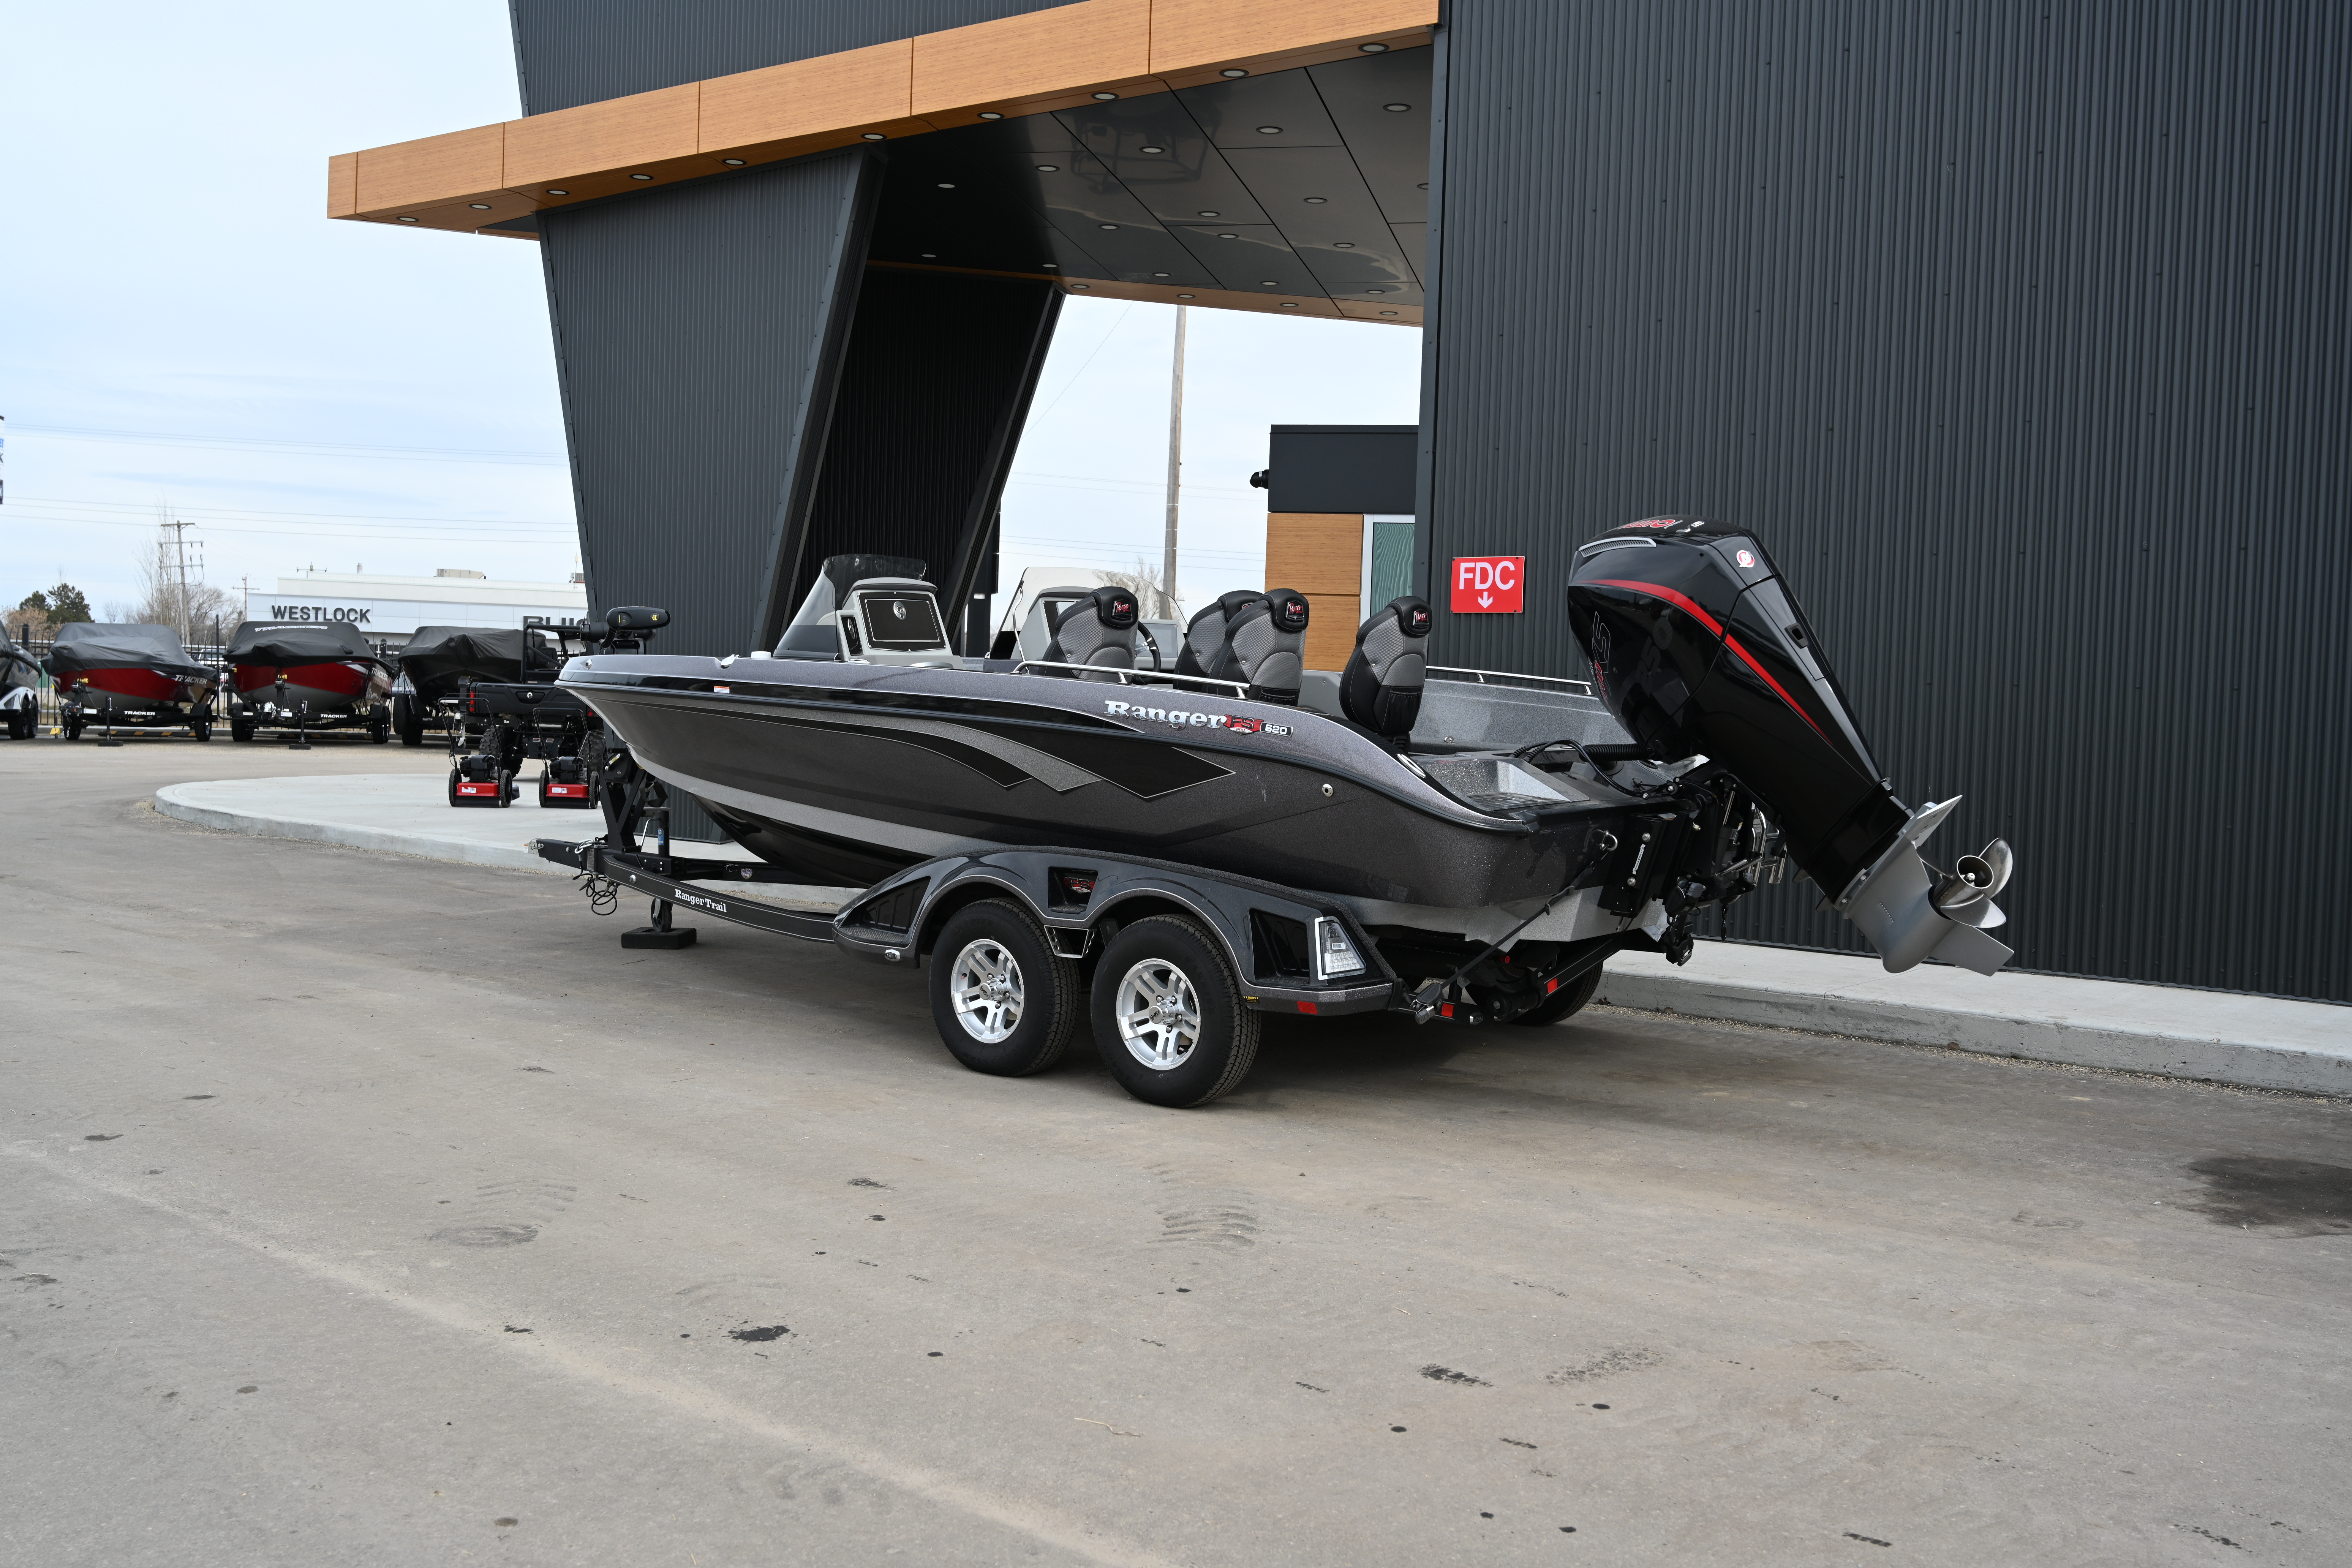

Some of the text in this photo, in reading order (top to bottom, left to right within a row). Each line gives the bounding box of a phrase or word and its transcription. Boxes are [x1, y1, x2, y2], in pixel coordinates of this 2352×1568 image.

[1459, 561, 1515, 590] FDC
[272, 605, 371, 623] WESTLOCK
[372, 667, 388, 681] TRACKER
[1103, 700, 1287, 735] Ranger FS 620
[1634, 847, 1644, 872] SLIDEMASTER
[675, 889, 727, 912] Ranger Trail
